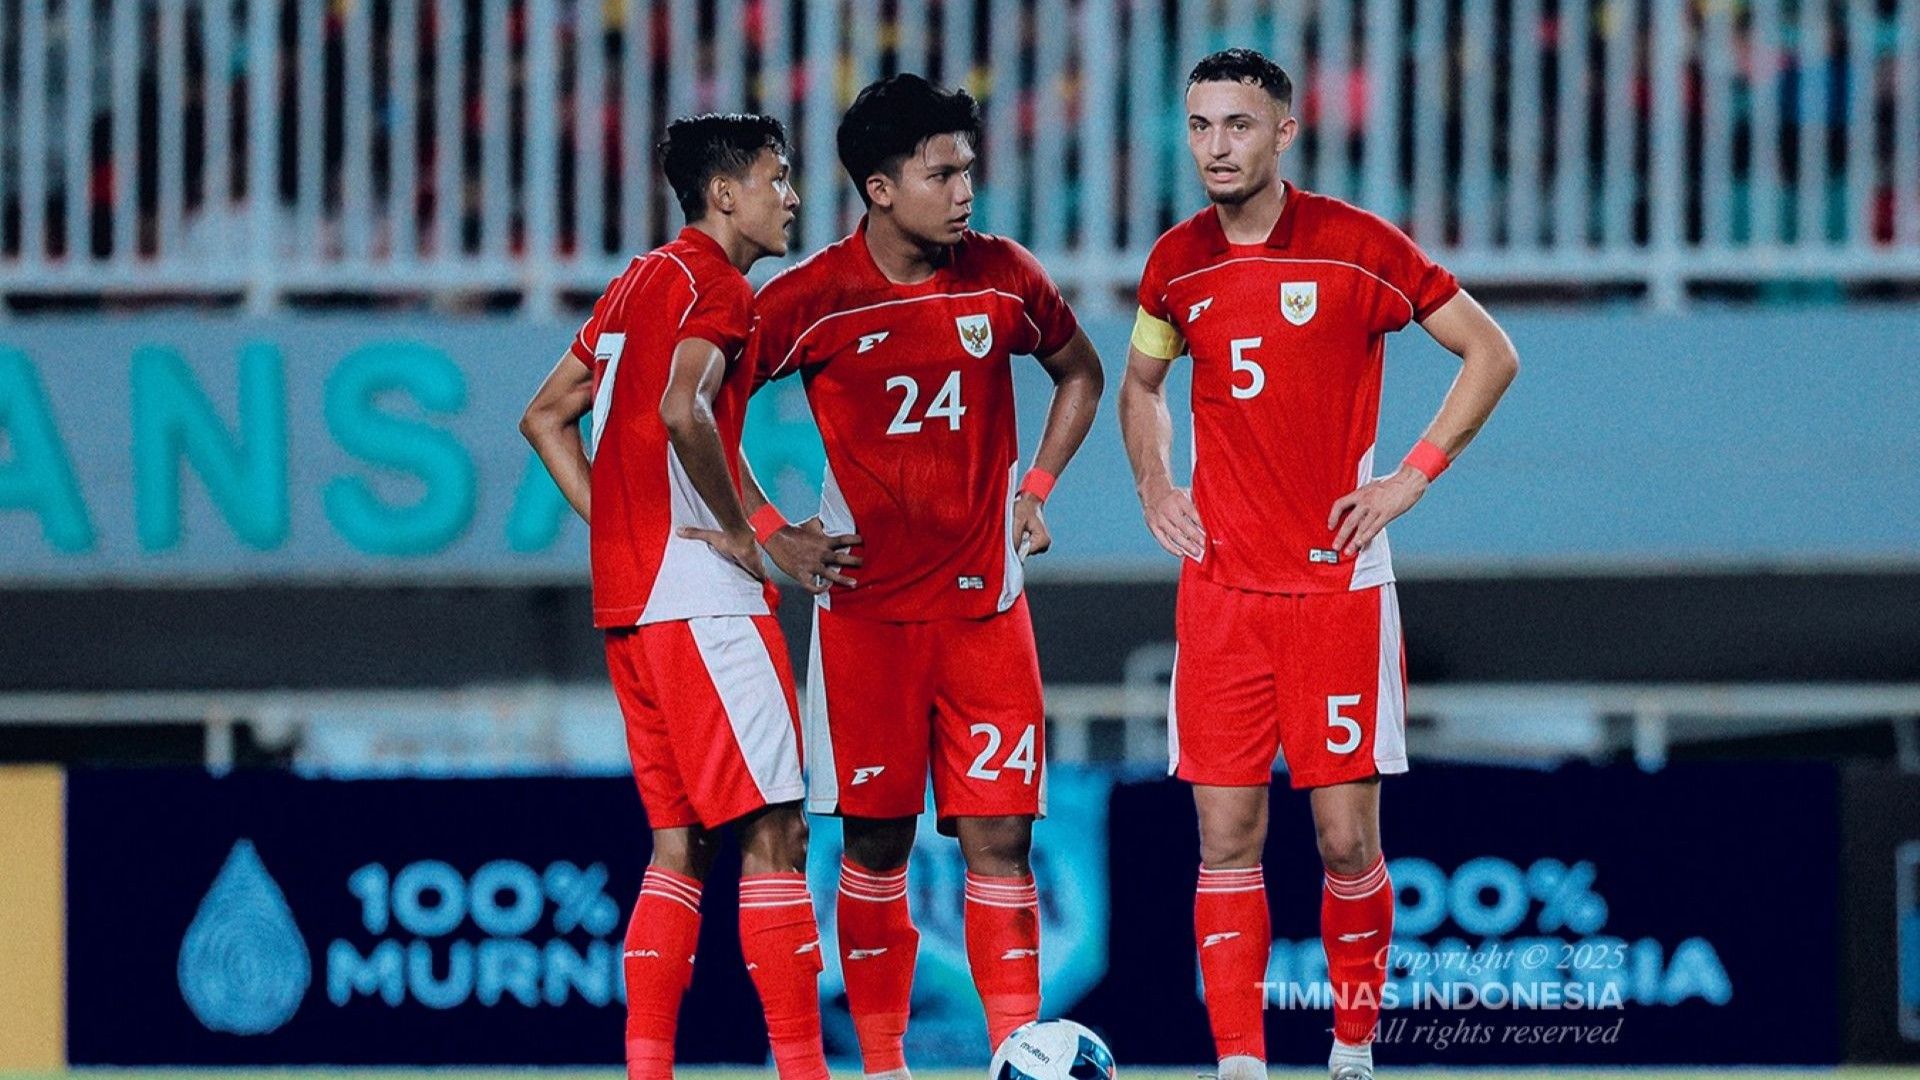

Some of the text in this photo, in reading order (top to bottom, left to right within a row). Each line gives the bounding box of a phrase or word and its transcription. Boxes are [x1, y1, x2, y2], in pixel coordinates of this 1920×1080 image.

[592, 332, 627, 464] 7
[1230, 336, 1266, 400] 5
[884, 370, 967, 436] 24
[966, 722, 1038, 786] 24
[1325, 694, 1362, 755] 5
[348, 860, 619, 936] 100%
[1390, 857, 1608, 935] 00%
[1020, 1041, 1050, 1065] molten
